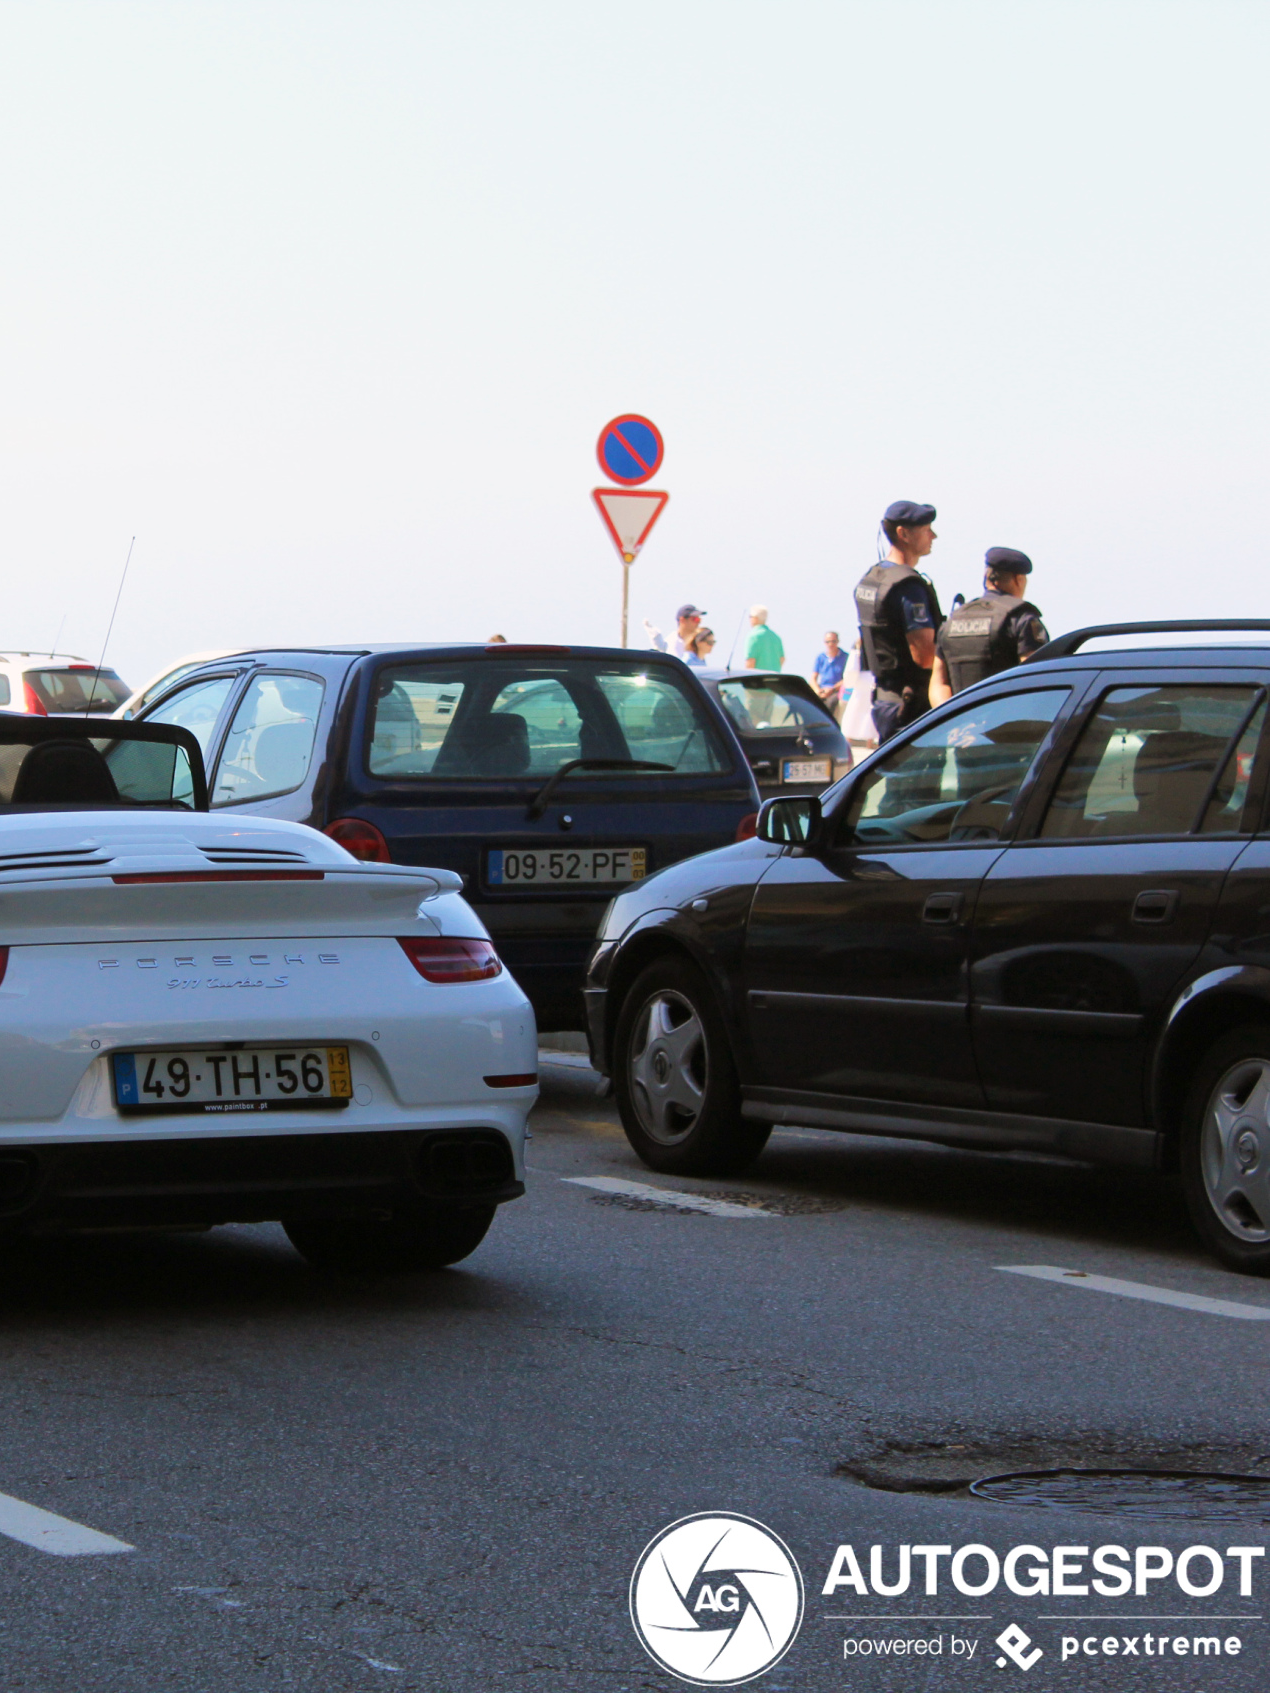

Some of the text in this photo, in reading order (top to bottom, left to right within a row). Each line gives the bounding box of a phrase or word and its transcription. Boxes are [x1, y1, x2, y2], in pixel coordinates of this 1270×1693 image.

[633, 851, 645, 860] 00
[633, 869, 644, 879] 03
[98, 953, 340, 970] PORSCHE
[167, 978, 201, 989] 911
[265, 975, 289, 989] S
[329, 1052, 346, 1067] 13
[121, 1084, 131, 1096] P
[331, 1079, 348, 1092] 12
